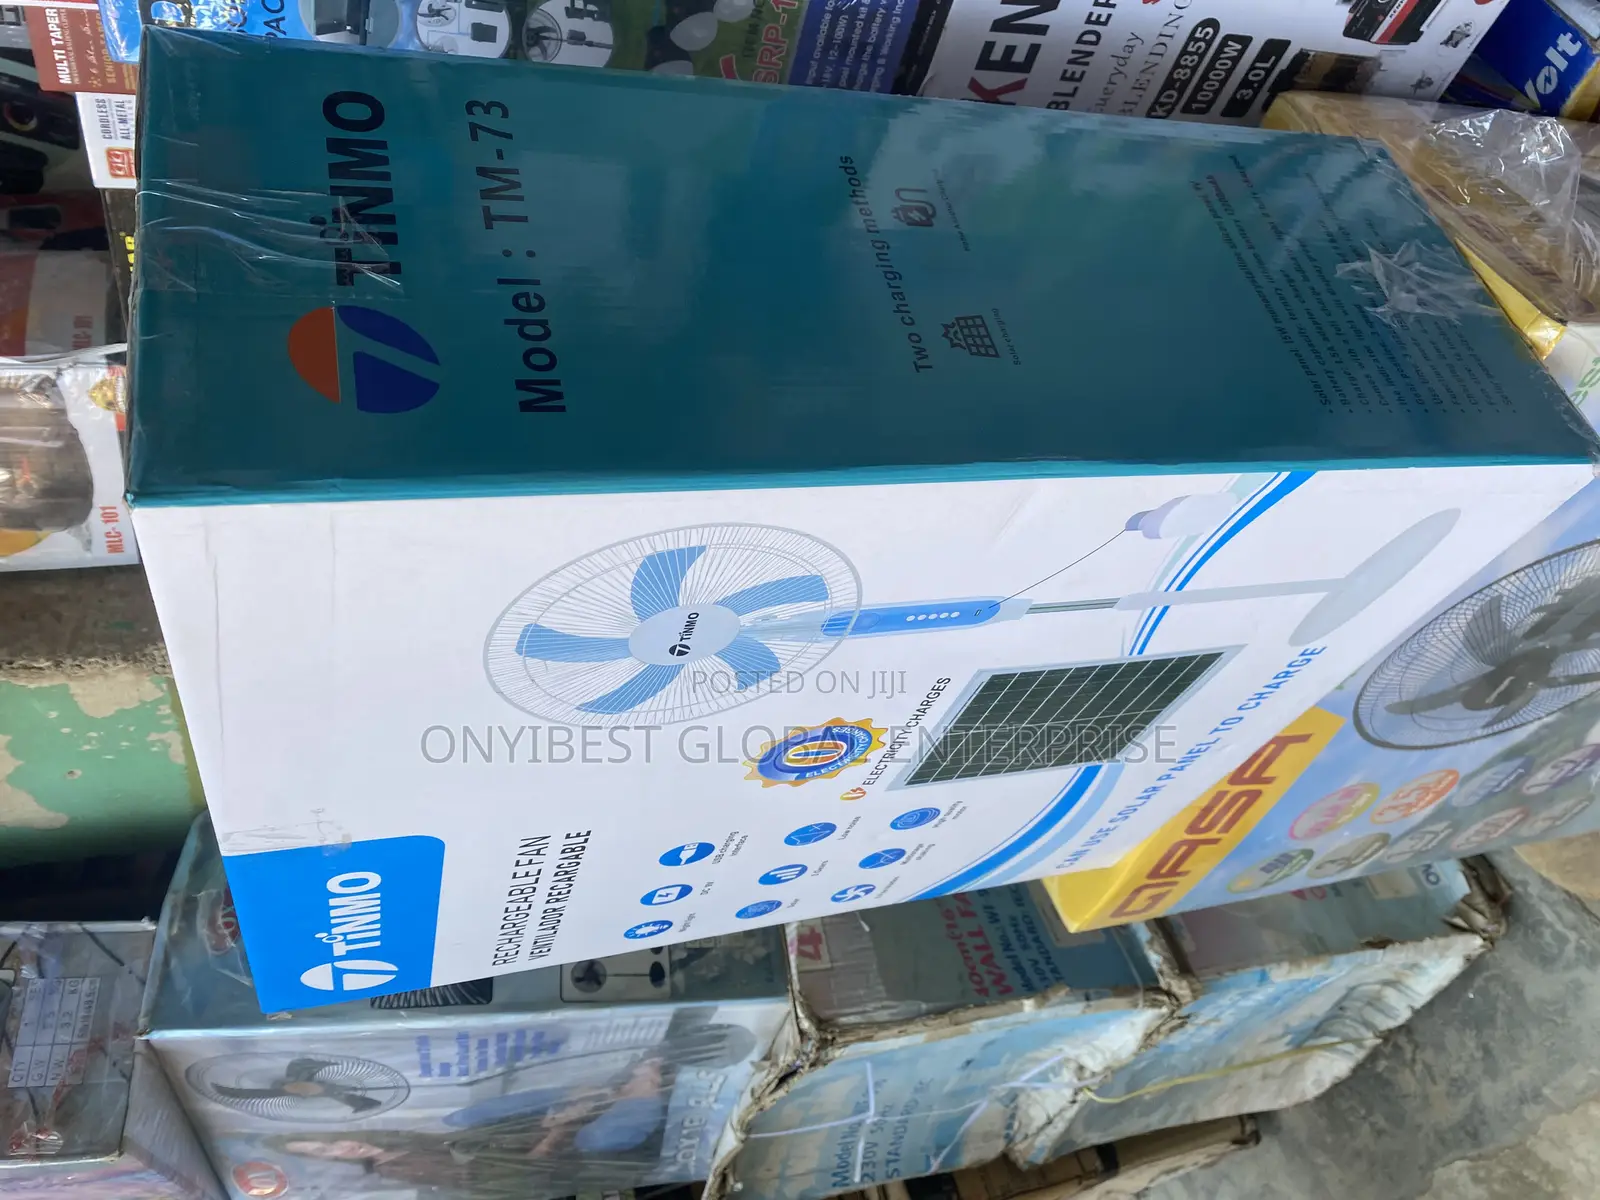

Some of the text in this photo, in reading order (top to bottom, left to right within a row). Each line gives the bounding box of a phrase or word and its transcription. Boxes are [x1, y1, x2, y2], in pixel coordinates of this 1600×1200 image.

[44, 8, 73, 84] MULTI TAPER
[812, 13, 832, 59] available
[843, 20, 865, 66] mounted
[856, 6, 868, 19] kit
[861, 44, 874, 61] the
[867, 7, 889, 43] battery
[1150, 26, 1215, 117] KD-8855
[1190, 40, 1243, 110] 10000W
[1236, 55, 1277, 101] 3.0L
[94, 98, 112, 140] CORDLESS
[114, 100, 131, 140] ALL-METAL
[464, 99, 528, 229] TM-73
[838, 155, 935, 373] Two charging methods
[497, 278, 567, 413] Model
[99, 505, 119, 524] 101
[863, 677, 951, 786] ELECTRICITY CHARGES
[1056, 645, 1328, 870] CAN USE SOLAR PANEL TO CHARGE
[492, 835, 551, 966] RECHARGEABLE FAN
[528, 830, 592, 960] VENTILADOR RECARGABLE
[967, 924, 1014, 996] WALL
[1003, 955, 1036, 991] Model
[830, 1140, 856, 1188] Model
[860, 1141, 879, 1183] 230V
